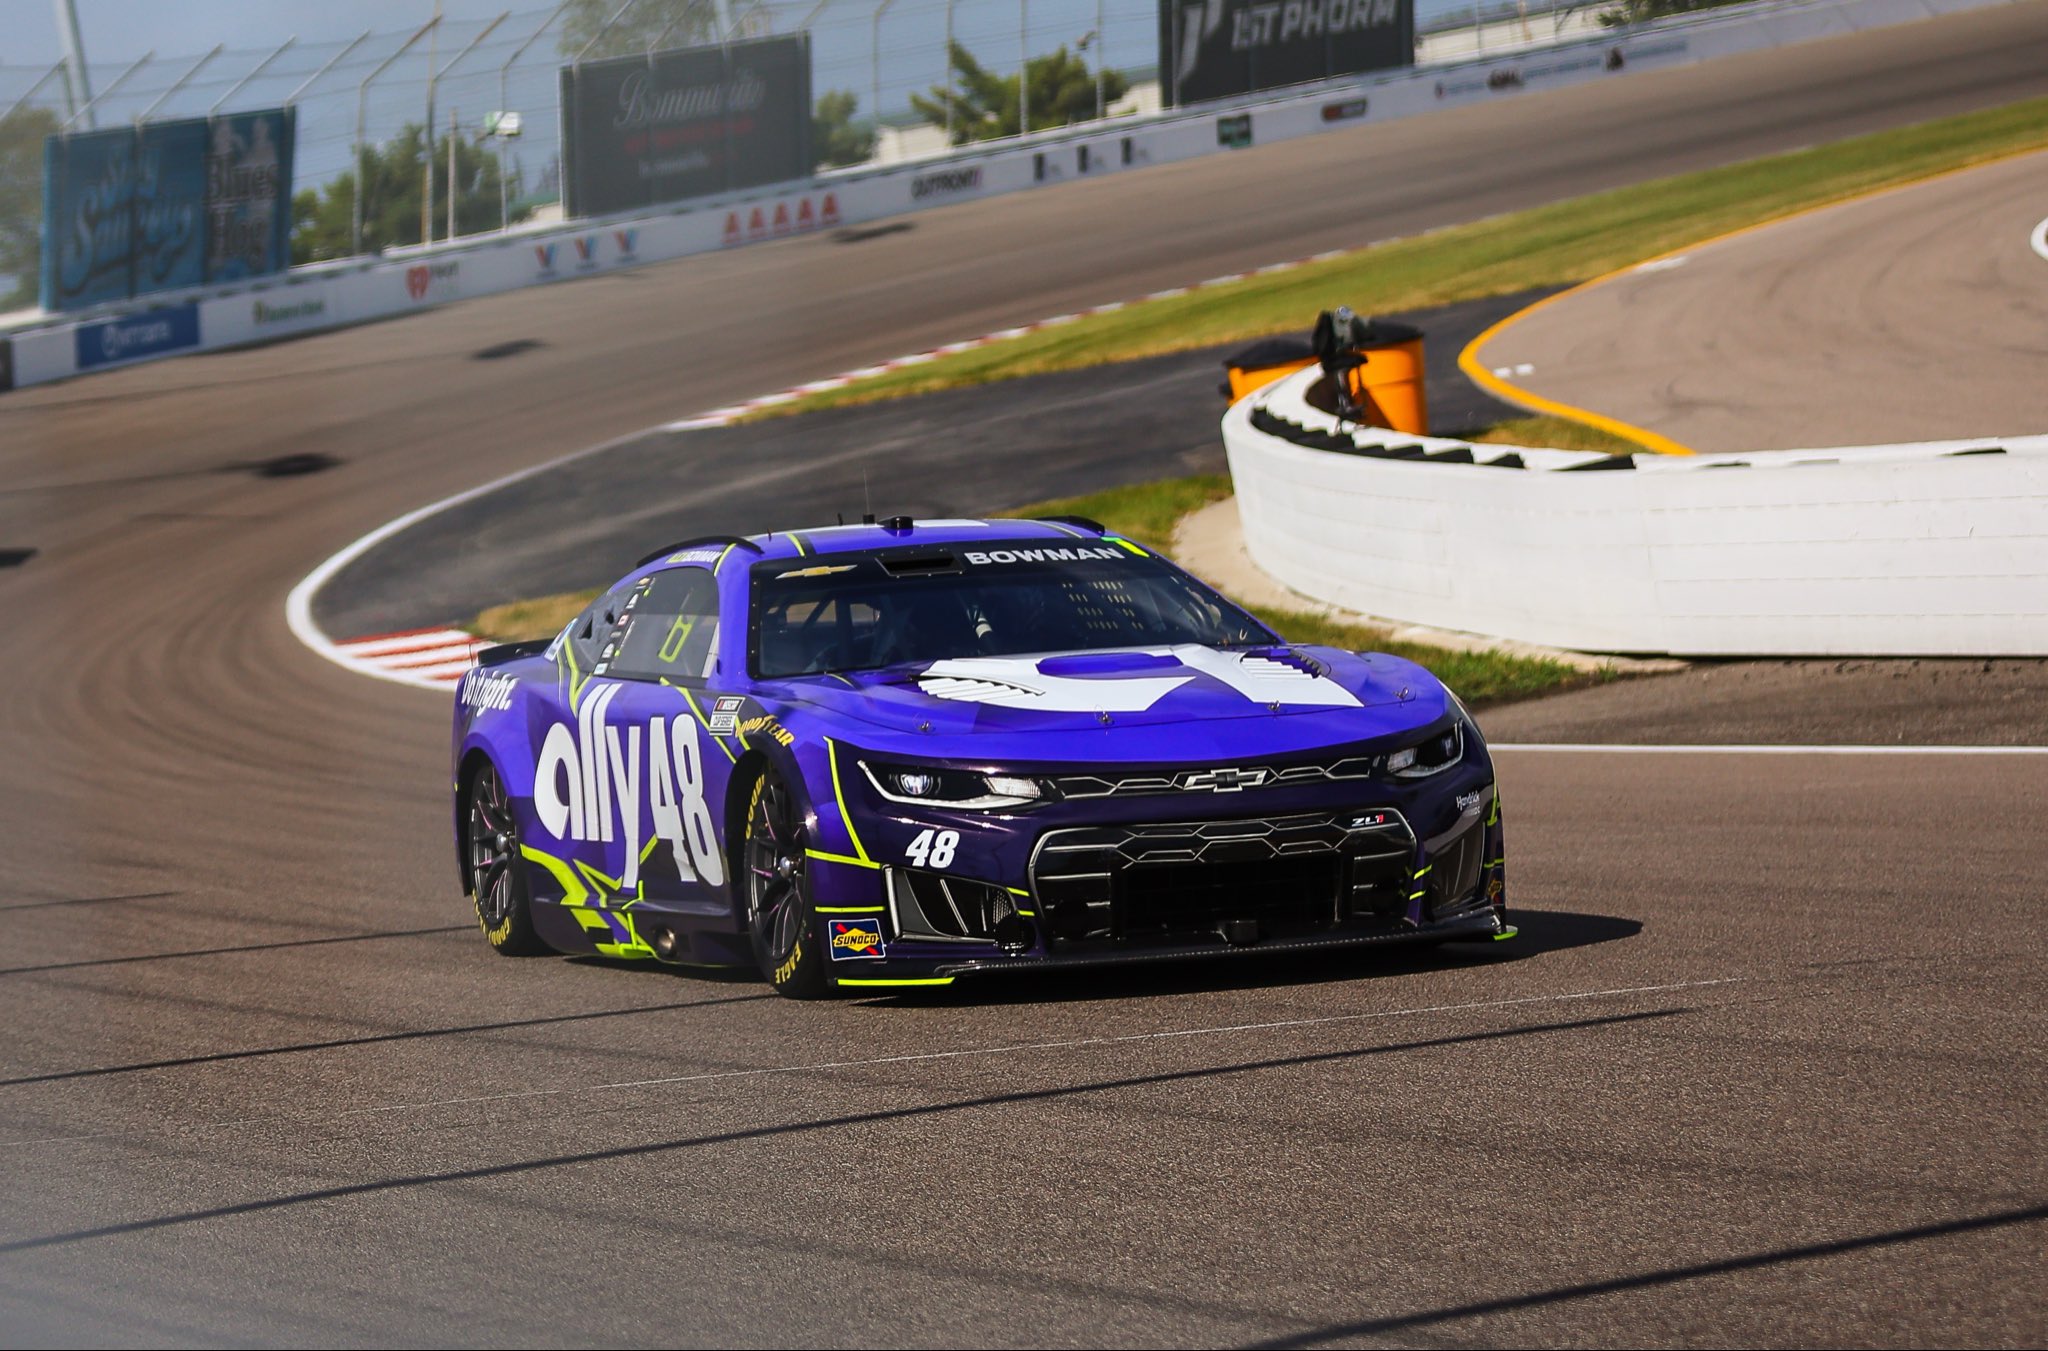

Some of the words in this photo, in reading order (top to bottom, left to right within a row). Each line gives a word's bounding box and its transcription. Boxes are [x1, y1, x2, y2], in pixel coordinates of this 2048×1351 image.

[964, 547, 1126, 565] BOWMAN
[534, 683, 641, 888] ally
[649, 713, 724, 886] 48
[1351, 814, 1384, 827] ZL1
[905, 829, 960, 869] 48
[835, 934, 877, 946] SUNOCO
